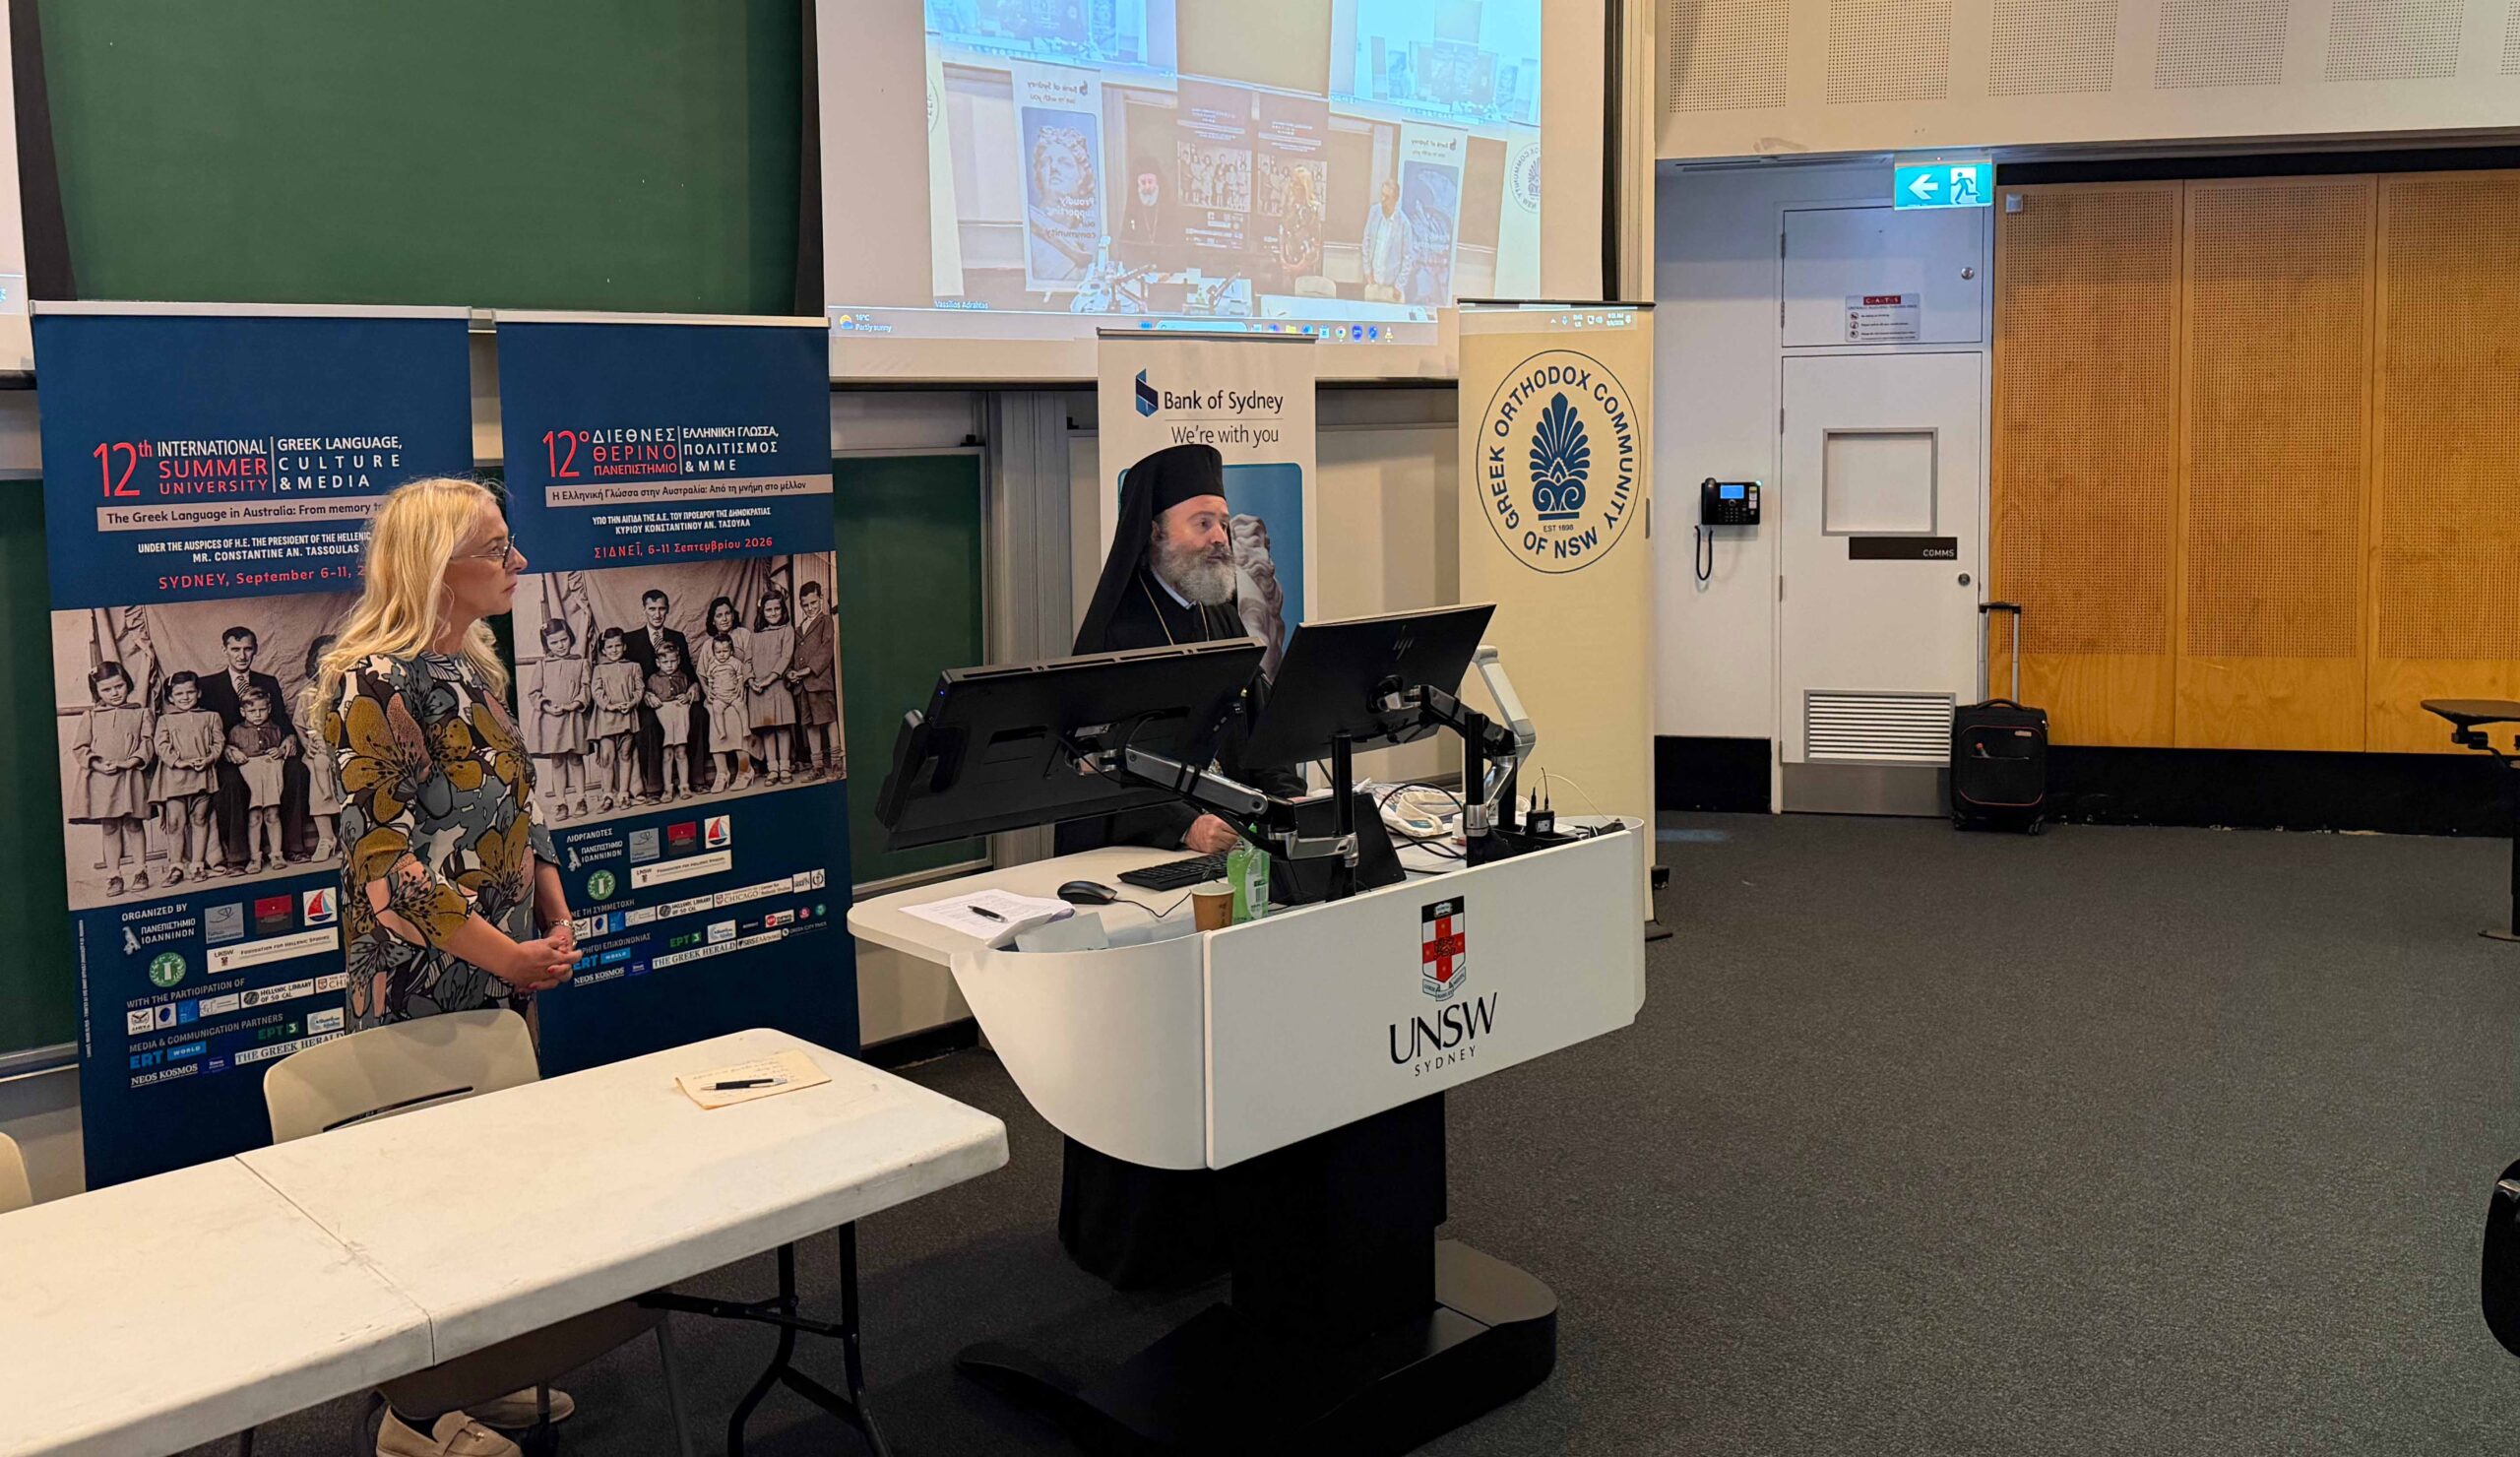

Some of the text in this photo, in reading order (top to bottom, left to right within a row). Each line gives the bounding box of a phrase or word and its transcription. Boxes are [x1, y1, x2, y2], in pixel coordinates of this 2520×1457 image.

[1165, 390, 1284, 414] Bank of Sydney
[593, 427, 675, 443] ΔΙΕΘΝΕΣ
[682, 426, 779, 438] ΕΛΛΗΝΙΚΗ ΓΛΩΣΣΑ,
[1171, 424, 1279, 448] We're with you
[158, 439, 268, 457] INTERNATIONAL
[278, 436, 403, 451] GREEK LANGUAGE,
[593, 444, 676, 462] ΘΕΡΙΝΟ
[684, 441, 778, 455] ΠΟΛΙΤΙΣΜΟΣ
[1488, 365, 1633, 530] GREEK ORTHODOX COMMUNITY
[158, 458, 269, 479] SUMMER
[279, 454, 401, 471] CULTURE
[594, 463, 677, 476] ΠΑΝΕΠΙΣΤΗΜΙΟ
[685, 461, 694, 473] &
[159, 478, 269, 495] UNIVERSITY
[280, 475, 370, 490] & MEDIA
[552, 491, 560, 501] Η
[562, 489, 603, 502] Ελληνική
[604, 488, 639, 498] Γλώσσα
[640, 488, 661, 499] στην
[709, 483, 726, 493] Από
[728, 484, 737, 495] τη
[738, 481, 763, 493] μνήμη
[780, 480, 806, 491] μέλλον
[106, 512, 129, 525] The
[133, 511, 168, 522] Greek
[171, 509, 227, 523] Language
[229, 507, 240, 519] in
[243, 505, 296, 518] Australia:
[298, 504, 326, 515] From
[329, 503, 371, 516] memory
[593, 516, 607, 526] ΥΠΟ
[607, 515, 621, 524] ΤΗΝ
[643, 513, 655, 522] ΤΗΣ
[670, 512, 683, 521] ΤΟΥ
[716, 509, 727, 518] ΤΗΣ
[615, 525, 643, 535] ΚΥΡΙΟΥ
[644, 521, 703, 533] ΚΟΝΣΤΑΝΤΙΝΟΥ
[138, 542, 166, 553] UNDER
[167, 541, 183, 551] THE
[184, 539, 221, 550] AUSPICES
[222, 538, 233, 548] OF
[234, 538, 250, 547] H.E.
[252, 537, 267, 546] THE
[268, 535, 309, 545] PRESIDENT
[310, 534, 321, 543] OF
[322, 533, 336, 542] THE
[745, 537, 773, 547] 2026
[1523, 526, 1599, 559] OF NSW
[193, 544, 360, 563] MR. CONSTANTINE AN. TASSOULAS
[1922, 548, 1955, 557] COMMS
[158, 573, 229, 590] SYDNEY,
[236, 569, 314, 586] September
[121, 903, 188, 921] ORGANIZED BY
[654, 942, 735, 968] THE GREEK HERALD
[574, 974, 594, 984] NEOS
[595, 966, 625, 981] KOSMOS
[126, 997, 151, 1009] WITH
[151, 994, 169, 1004] THE
[234, 978, 245, 987] OF
[129, 1040, 158, 1053] MEDIA
[158, 1038, 165, 1046] &
[167, 1022, 240, 1045] COMMUNICATION
[241, 1013, 284, 1030] PARTNERS
[1389, 991, 1497, 1065] UNSW
[129, 1045, 201, 1070] ERT WORLD
[236, 1049, 259, 1063] THE
[261, 1042, 297, 1057] GREEK
[1415, 1045, 1477, 1077] SYDNEY
[131, 1072, 158, 1086] NEOS
[158, 1063, 199, 1079] KOSMOS
